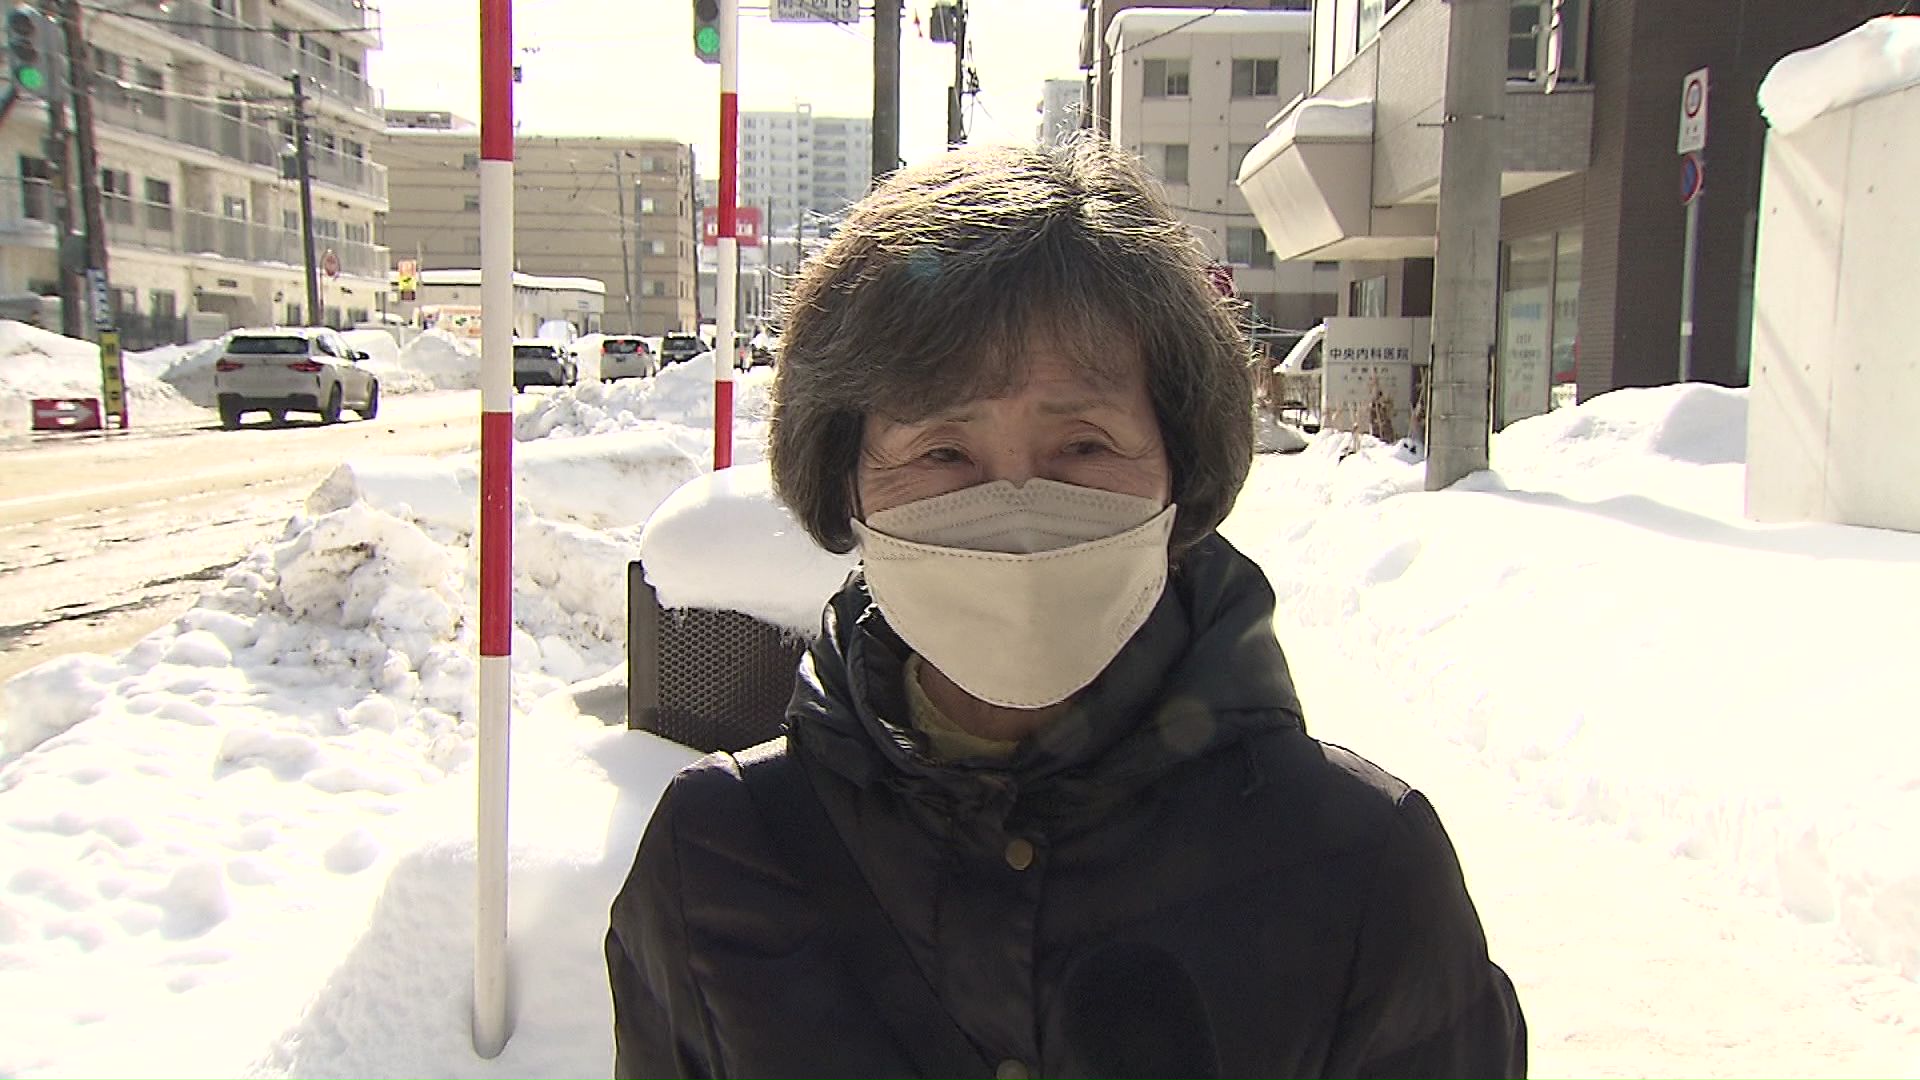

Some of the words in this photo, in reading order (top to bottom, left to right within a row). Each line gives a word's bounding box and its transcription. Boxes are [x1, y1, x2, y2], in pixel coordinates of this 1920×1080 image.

[1329, 347, 1409, 361] 中央内科医院
